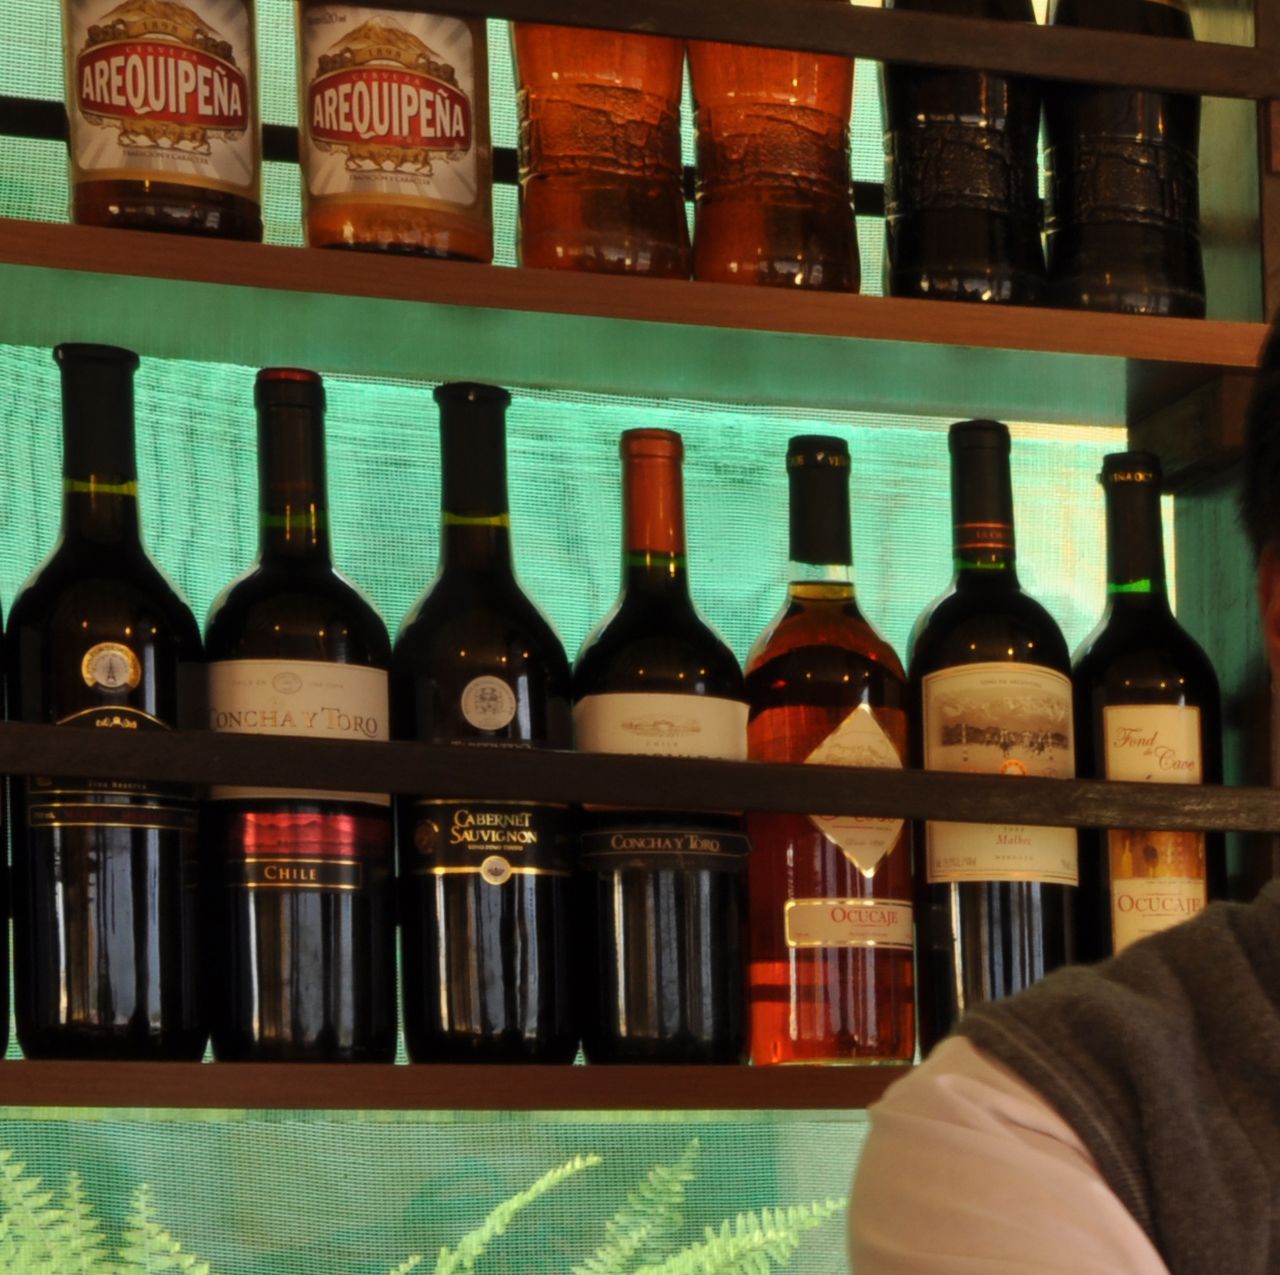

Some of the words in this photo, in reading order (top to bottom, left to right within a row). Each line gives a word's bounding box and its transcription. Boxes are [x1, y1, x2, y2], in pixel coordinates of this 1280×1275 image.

[126, 44, 199, 62] CERVEZA
[82, 54, 243, 117] AREQUIPEÑA
[352, 71, 421, 87] CERVEZA
[313, 80, 465, 140] AREQUIPEÑA
[320, 706, 379, 738] TORO
[1113, 726, 1158, 749] Fond
[1154, 745, 1196, 772] Cave
[454, 808, 533, 829] CABERNET
[450, 825, 538, 845] SAUVIGNON
[610, 833, 672, 850] CONCHA
[672, 838, 685, 850] Y
[684, 833, 721, 853] TORO
[996, 833, 1032, 846] Malbec
[263, 864, 318, 881] CHILE
[1117, 895, 1201, 914] OCUCAJE
[830, 907, 899, 927] OCUCAJE
